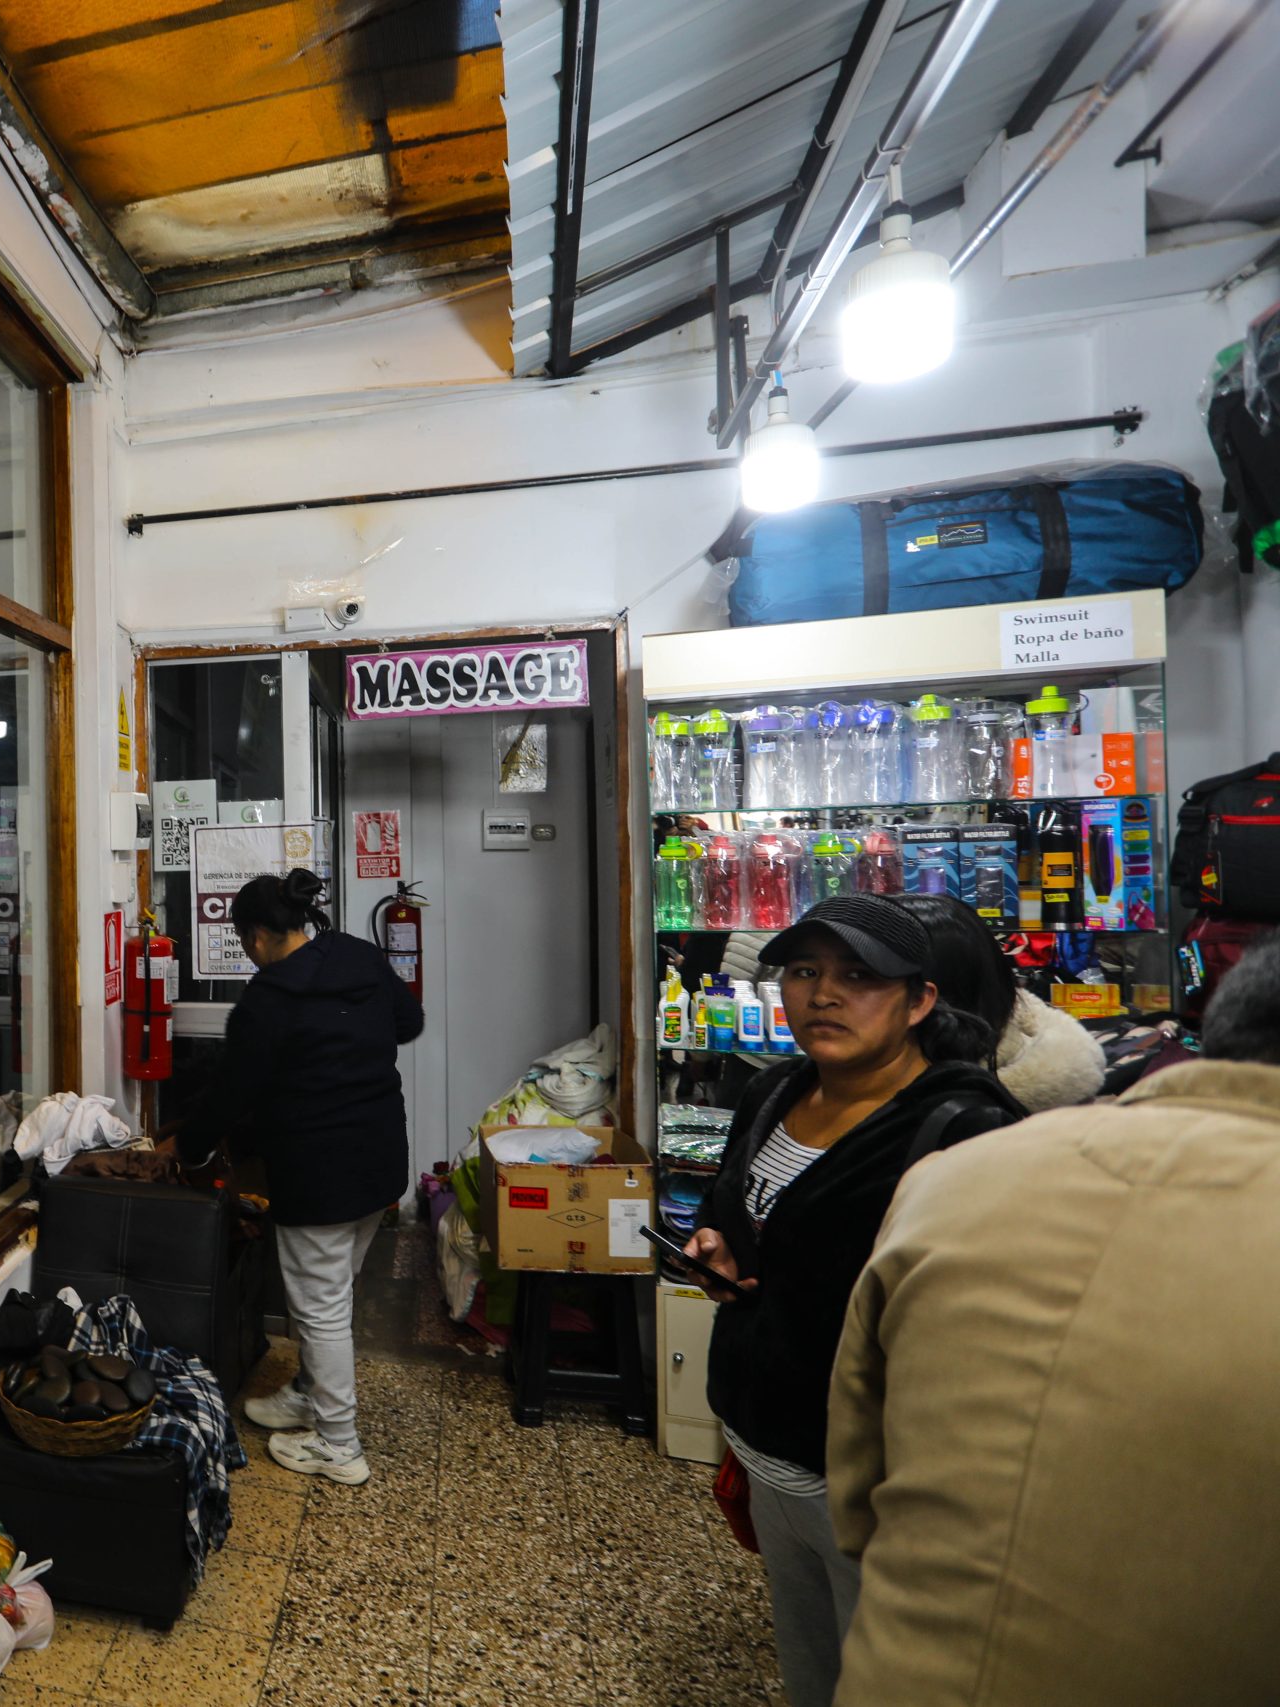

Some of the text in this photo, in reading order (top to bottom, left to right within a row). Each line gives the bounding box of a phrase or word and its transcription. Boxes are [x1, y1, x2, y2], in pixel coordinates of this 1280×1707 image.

[1013, 609, 1089, 626] Swimsuit
[1014, 627, 1124, 647] Ropa de baño
[1014, 650, 1060, 664] Malla
[352, 646, 581, 714] MASSAGE
